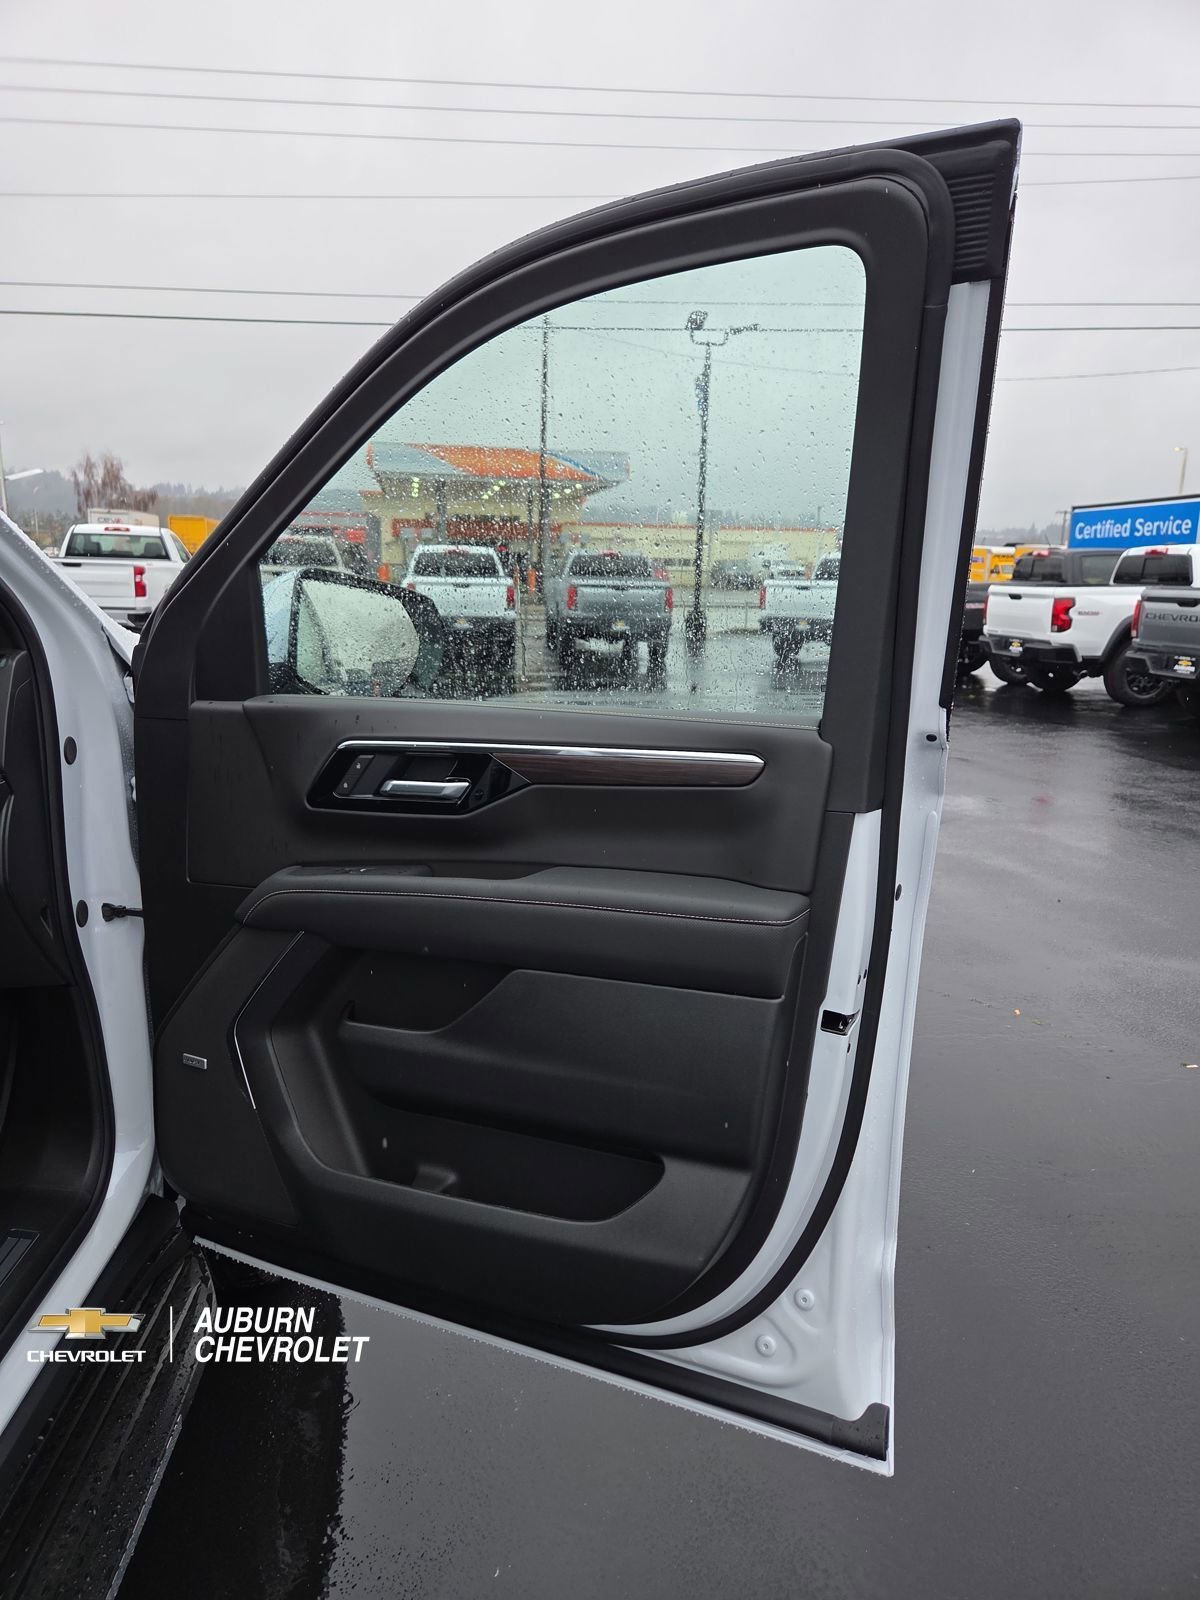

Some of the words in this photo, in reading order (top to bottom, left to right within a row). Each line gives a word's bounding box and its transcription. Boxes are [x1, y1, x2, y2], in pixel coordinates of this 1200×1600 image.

[1075, 518, 1132, 539] Certified
[1134, 515, 1192, 537] Service
[1145, 612, 1200, 623] CHEVRO
